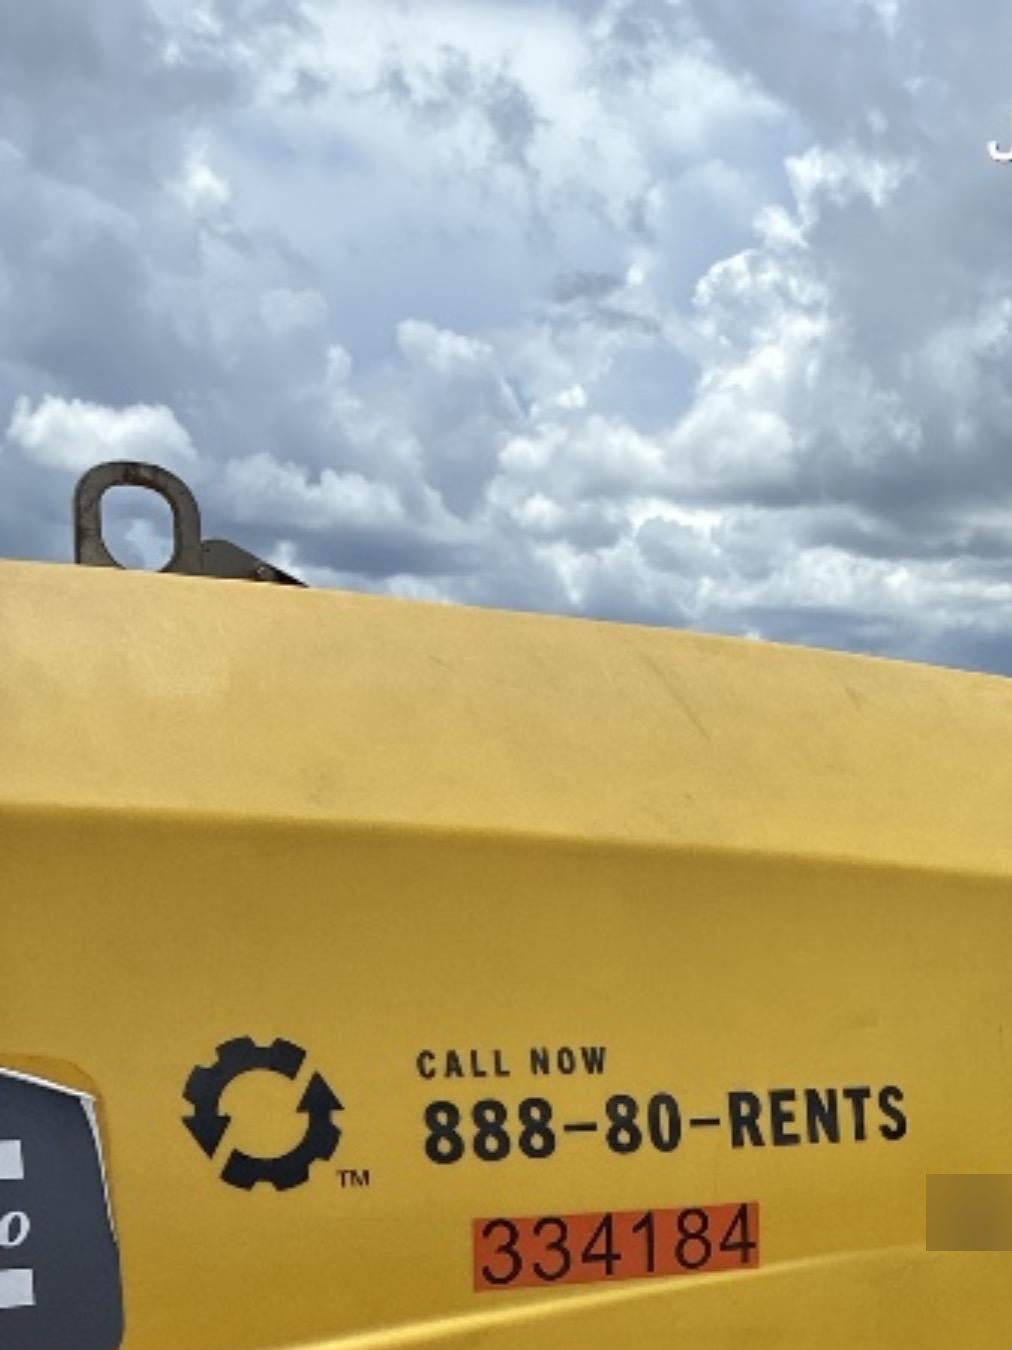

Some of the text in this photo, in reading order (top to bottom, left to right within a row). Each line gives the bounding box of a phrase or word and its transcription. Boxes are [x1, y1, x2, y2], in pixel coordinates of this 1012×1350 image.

[416, 1046, 607, 1080] CALL NOW
[424, 1085, 908, 1165] 888-80-RENTS
[482, 1203, 756, 1286] 334184
